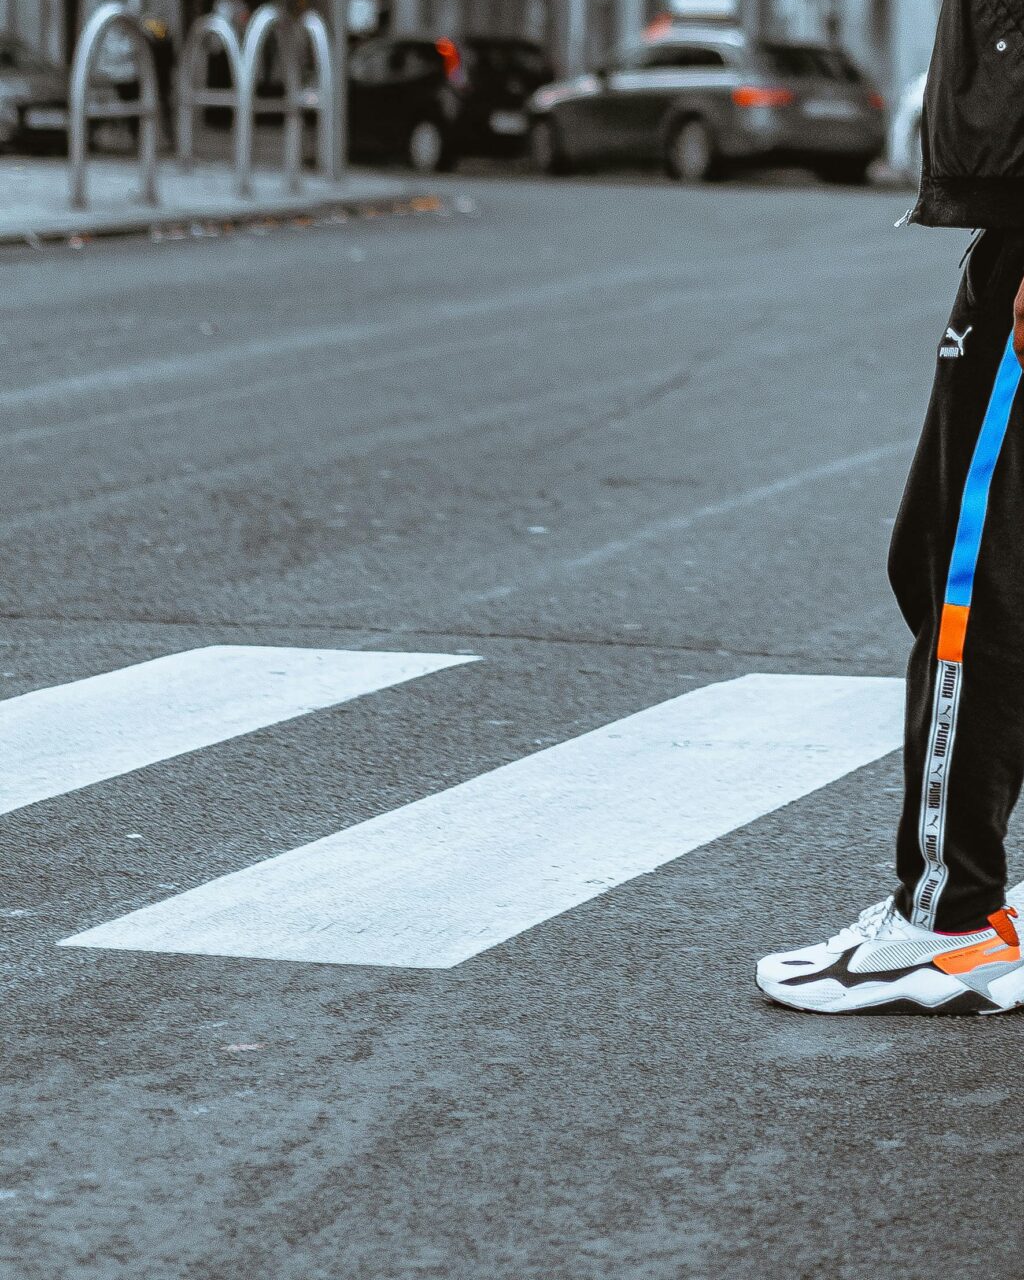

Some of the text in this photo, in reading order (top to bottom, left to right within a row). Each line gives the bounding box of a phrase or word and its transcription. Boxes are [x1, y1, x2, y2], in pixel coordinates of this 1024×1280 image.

[942, 663, 956, 698] PUMA
[934, 722, 950, 757] PUMA
[928, 781, 942, 809] PUMA
[920, 879, 939, 910] PUMA
